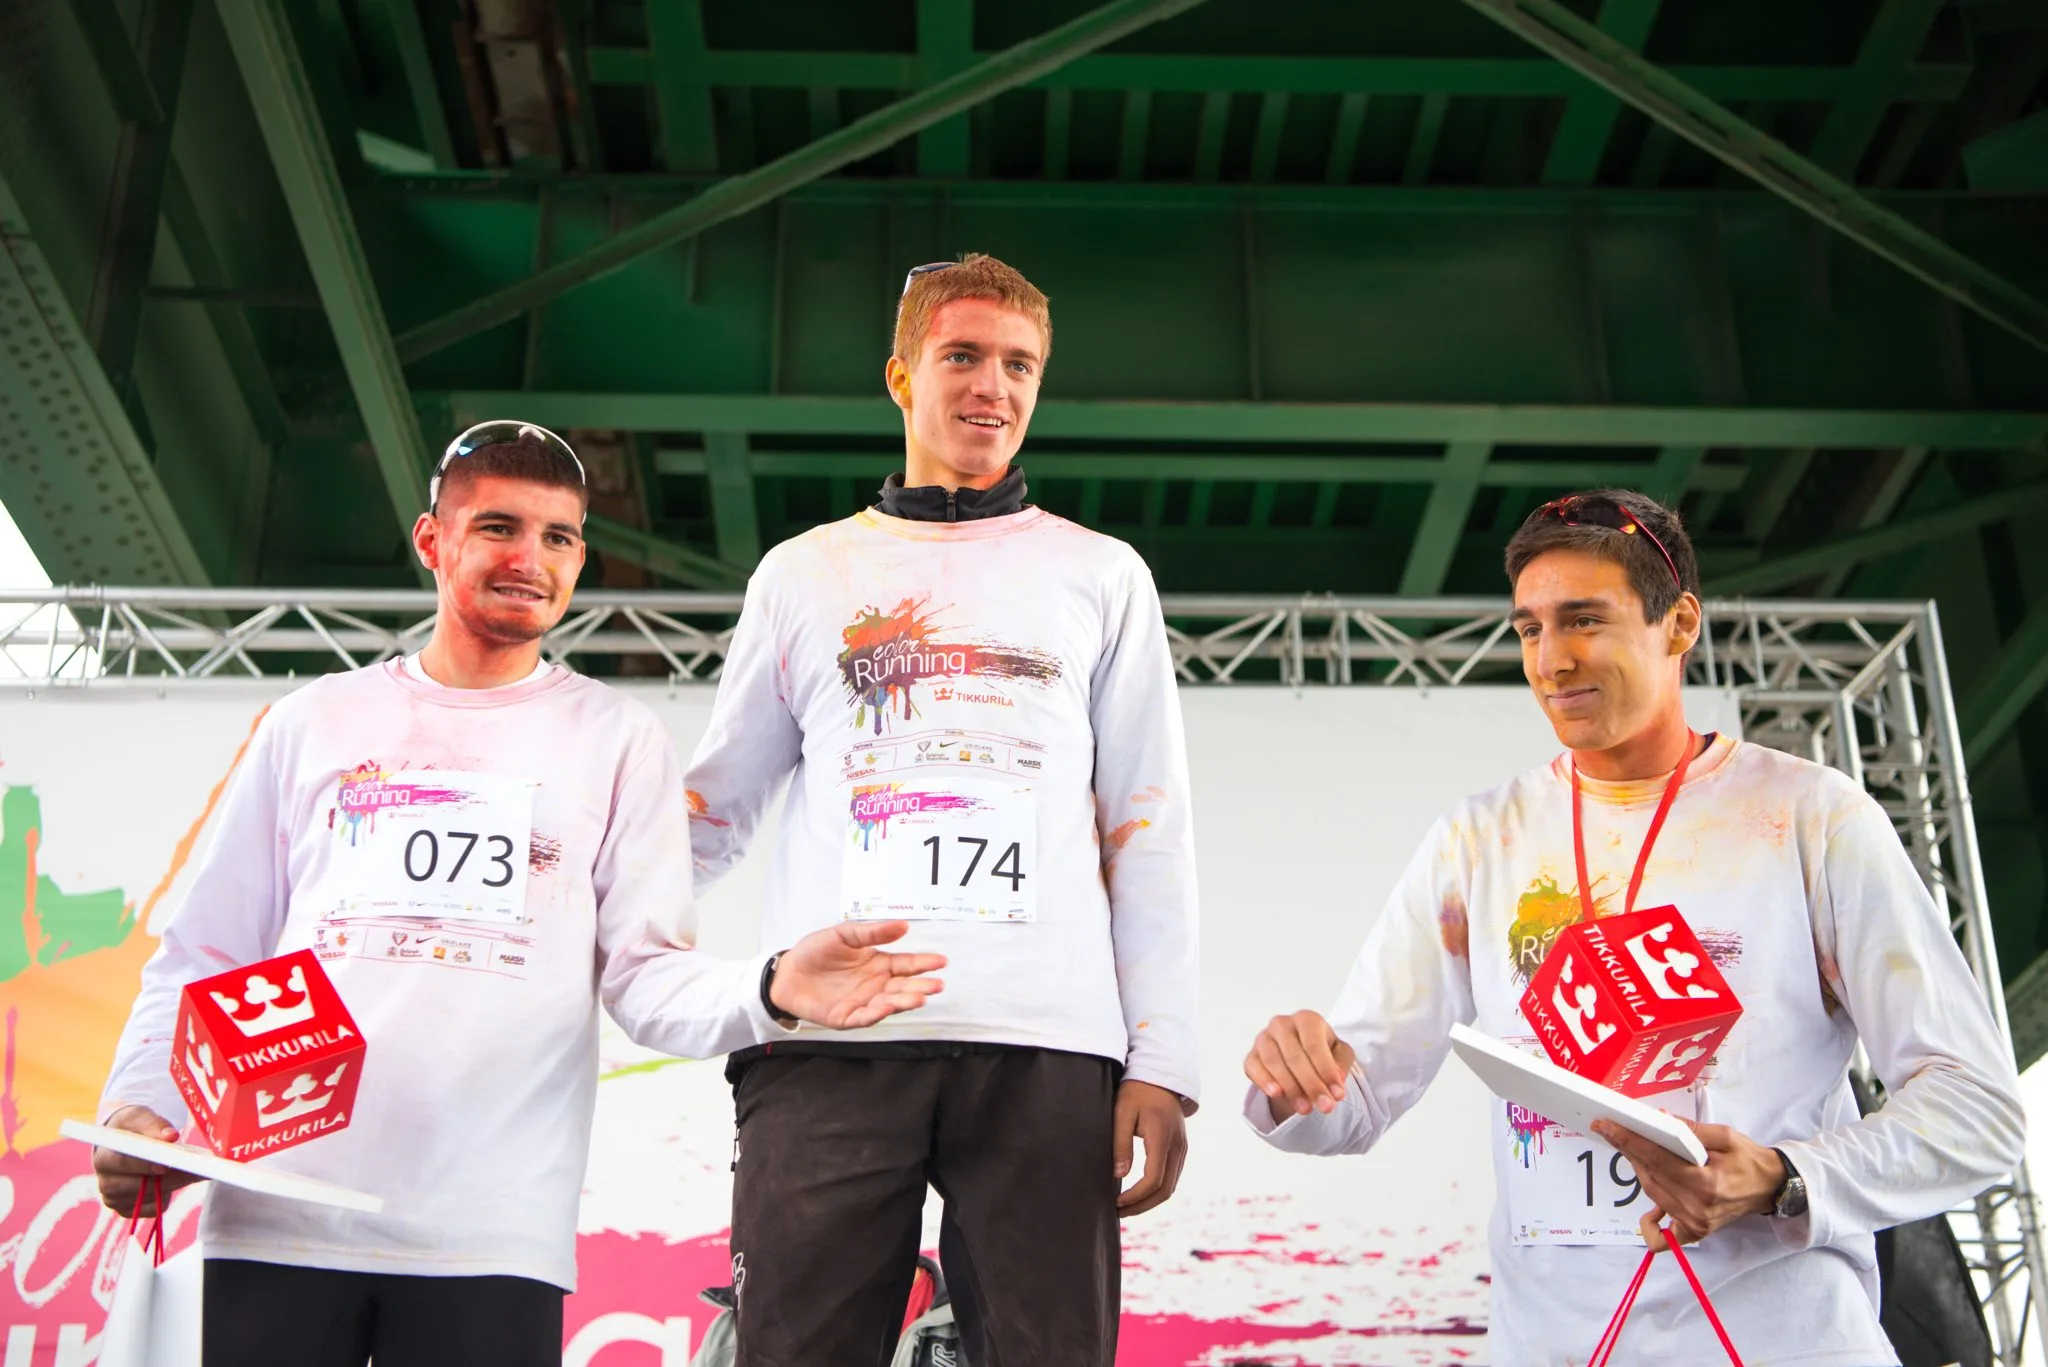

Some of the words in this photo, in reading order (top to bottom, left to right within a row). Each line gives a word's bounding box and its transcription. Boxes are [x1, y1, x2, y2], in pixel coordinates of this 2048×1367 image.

[854, 648, 966, 688] Running
[873, 632, 919, 660] color
[956, 692, 1015, 707] TIKKURILA
[341, 786, 411, 807] Running
[846, 768, 876, 780] NISSAN
[855, 796, 920, 816] Running
[404, 829, 514, 888] 073
[923, 836, 1026, 891] 174
[1583, 924, 1656, 1027] TIKKURILA
[228, 1024, 355, 1073] TIKKURILA
[1526, 990, 1579, 1073] TIKKURI
[1609, 1032, 1661, 1091] TIKKURI
[230, 1111, 346, 1159] TIKKURILA
[1577, 1150, 1641, 1207] 19
